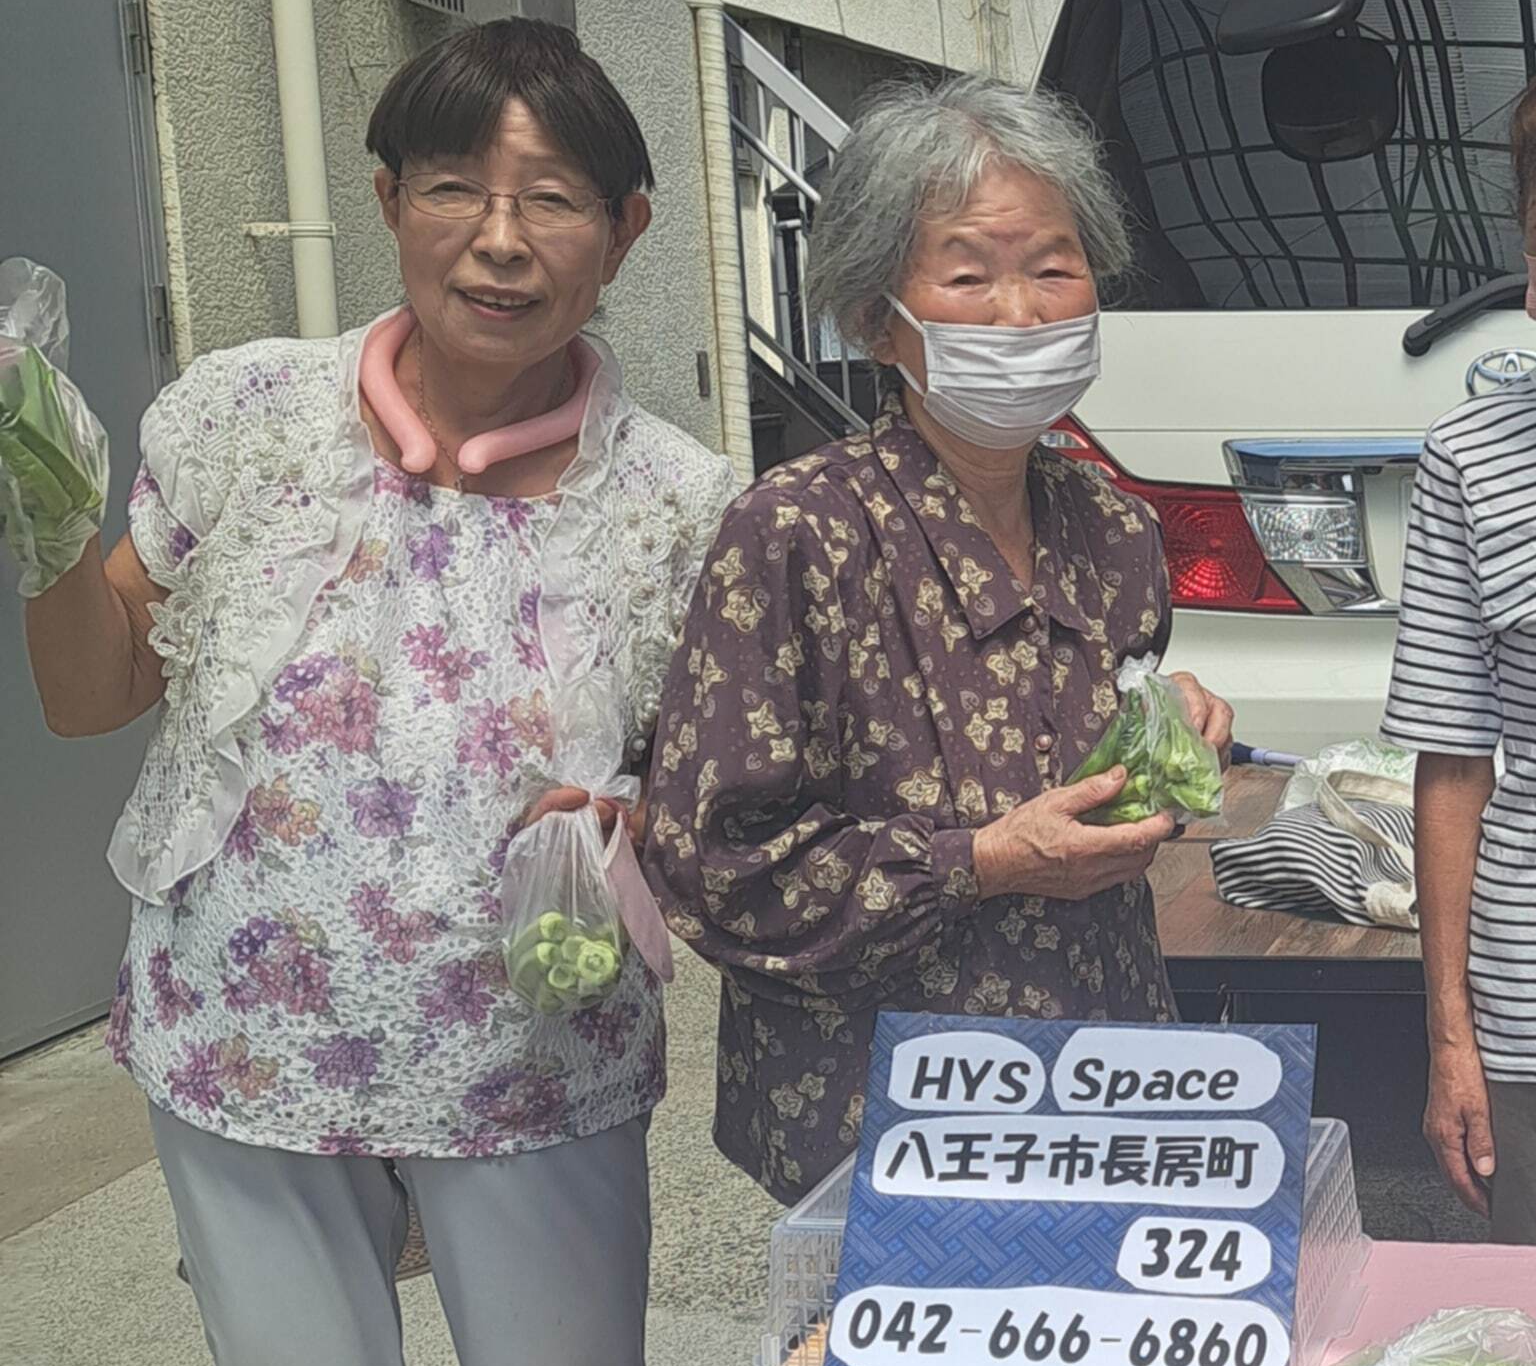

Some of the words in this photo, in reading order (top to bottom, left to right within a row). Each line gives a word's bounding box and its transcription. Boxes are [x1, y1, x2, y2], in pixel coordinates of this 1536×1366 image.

[909, 1055, 1031, 1104] HYS
[1069, 1057, 1239, 1108] Space
[885, 1129, 1260, 1189] 八王子市長房町
[1140, 1227, 1243, 1282] 324
